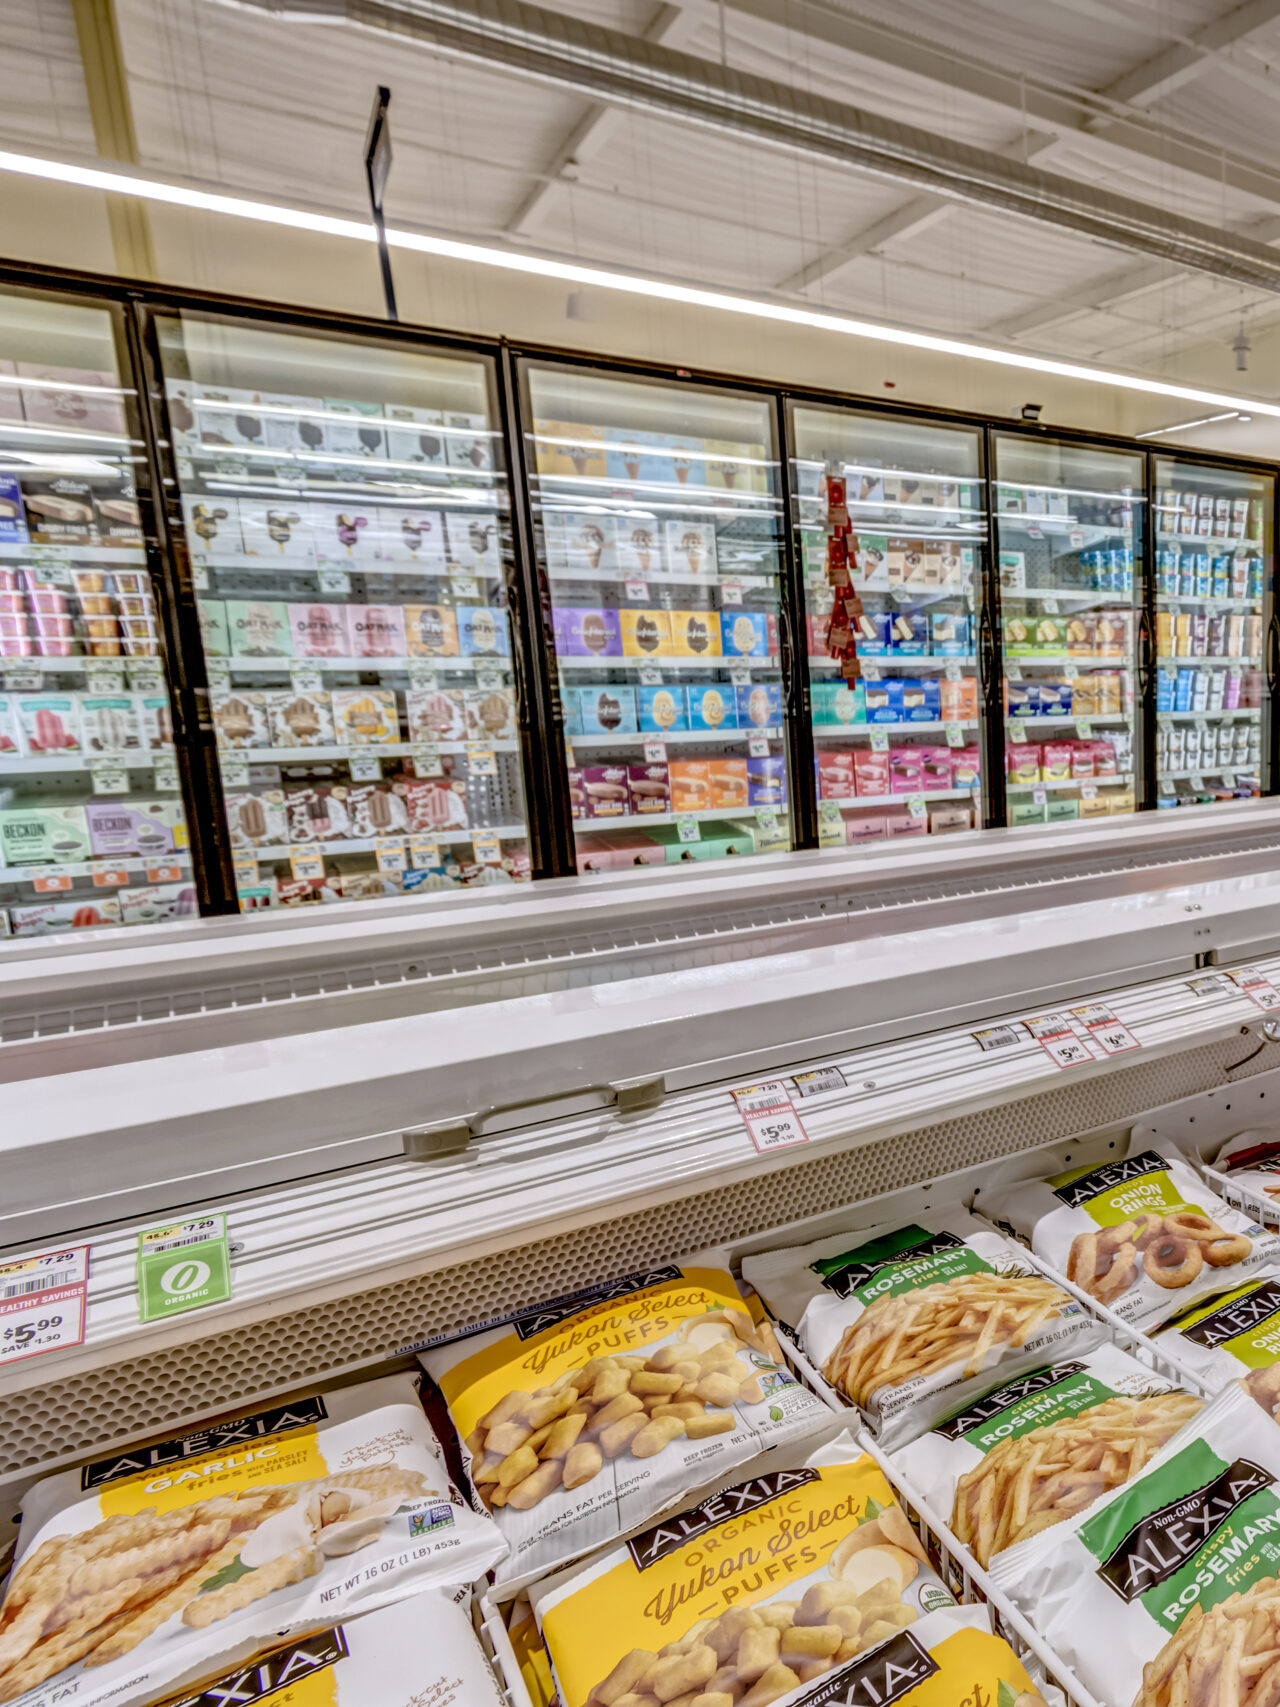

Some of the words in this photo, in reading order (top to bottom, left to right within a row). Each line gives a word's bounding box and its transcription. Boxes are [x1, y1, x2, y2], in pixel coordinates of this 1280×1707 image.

[3, 822, 46, 839] BECKON
[92, 816, 133, 832] BECKON
[1071, 1157, 1164, 1206] ALEXIA
[1113, 1178, 1145, 1195] crispy
[1109, 1182, 1163, 1209] ONION
[1120, 1193, 1168, 1216] RINGS
[863, 1249, 968, 1301] ROSEMARY
[892, 1257, 928, 1272] crispy
[911, 1268, 940, 1286] fries
[0, 1298, 39, 1315] EALTHY
[41, 1286, 84, 1303] SAVINGS
[164, 1288, 209, 1306] ORGANIC
[1217, 1297, 1250, 1320] Non-GMO
[557, 1289, 664, 1336] ORGANIC
[521, 1315, 622, 1375] Yukon
[628, 1291, 711, 1326] Select
[586, 1314, 671, 1357] PUFFS
[1251, 1318, 1280, 1339] crispy
[0, 1341, 30, 1354] SAVE
[394, 1341, 420, 1355] LOAD
[421, 1333, 448, 1347] LIMIT
[784, 1397, 820, 1418] PLANTS
[952, 1363, 1082, 1435] ALEXIA
[1010, 1392, 1049, 1416] crispy
[979, 1380, 1096, 1446] ROSEMARY
[1034, 1405, 1066, 1425] fries
[173, 1418, 249, 1444] Non-GMO
[730, 1433, 748, 1447] NET
[91, 1412, 318, 1481] ALEXIA
[135, 1455, 211, 1483] Yukon
[213, 1434, 286, 1458] Select
[264, 1448, 309, 1467] PARSLEY
[683, 1452, 698, 1465] KEEP
[698, 1442, 725, 1456] FROZEN
[143, 1445, 282, 1495] GARLIC
[262, 1464, 281, 1476] SEA
[283, 1455, 309, 1471] SALT
[185, 1469, 243, 1493] fries
[536, 1508, 574, 1535] TRANS
[575, 1496, 595, 1513] FAT
[597, 1488, 613, 1502] PER
[614, 1469, 652, 1494] SERVING
[1152, 1496, 1203, 1531] Non-GMO
[641, 1472, 805, 1559] ALEXIA
[684, 1499, 804, 1569] ORGANIC
[1123, 1473, 1260, 1593] ALEXIA
[1194, 1525, 1235, 1568] crispy
[1267, 1548, 1280, 1564] SEA
[320, 1585, 343, 1605] NET
[343, 1575, 363, 1592] WT
[364, 1565, 378, 1581] 16
[380, 1559, 397, 1575] OZ
[398, 1553, 410, 1568] (1
[412, 1545, 432, 1561] LB)
[434, 1536, 462, 1553] 453g
[642, 1546, 762, 1627] Yukon
[766, 1494, 862, 1557] Select
[1224, 1552, 1262, 1588] fries
[720, 1544, 819, 1606] PUFFS
[925, 1587, 946, 1600] USDA
[51, 1681, 82, 1703] FAT
